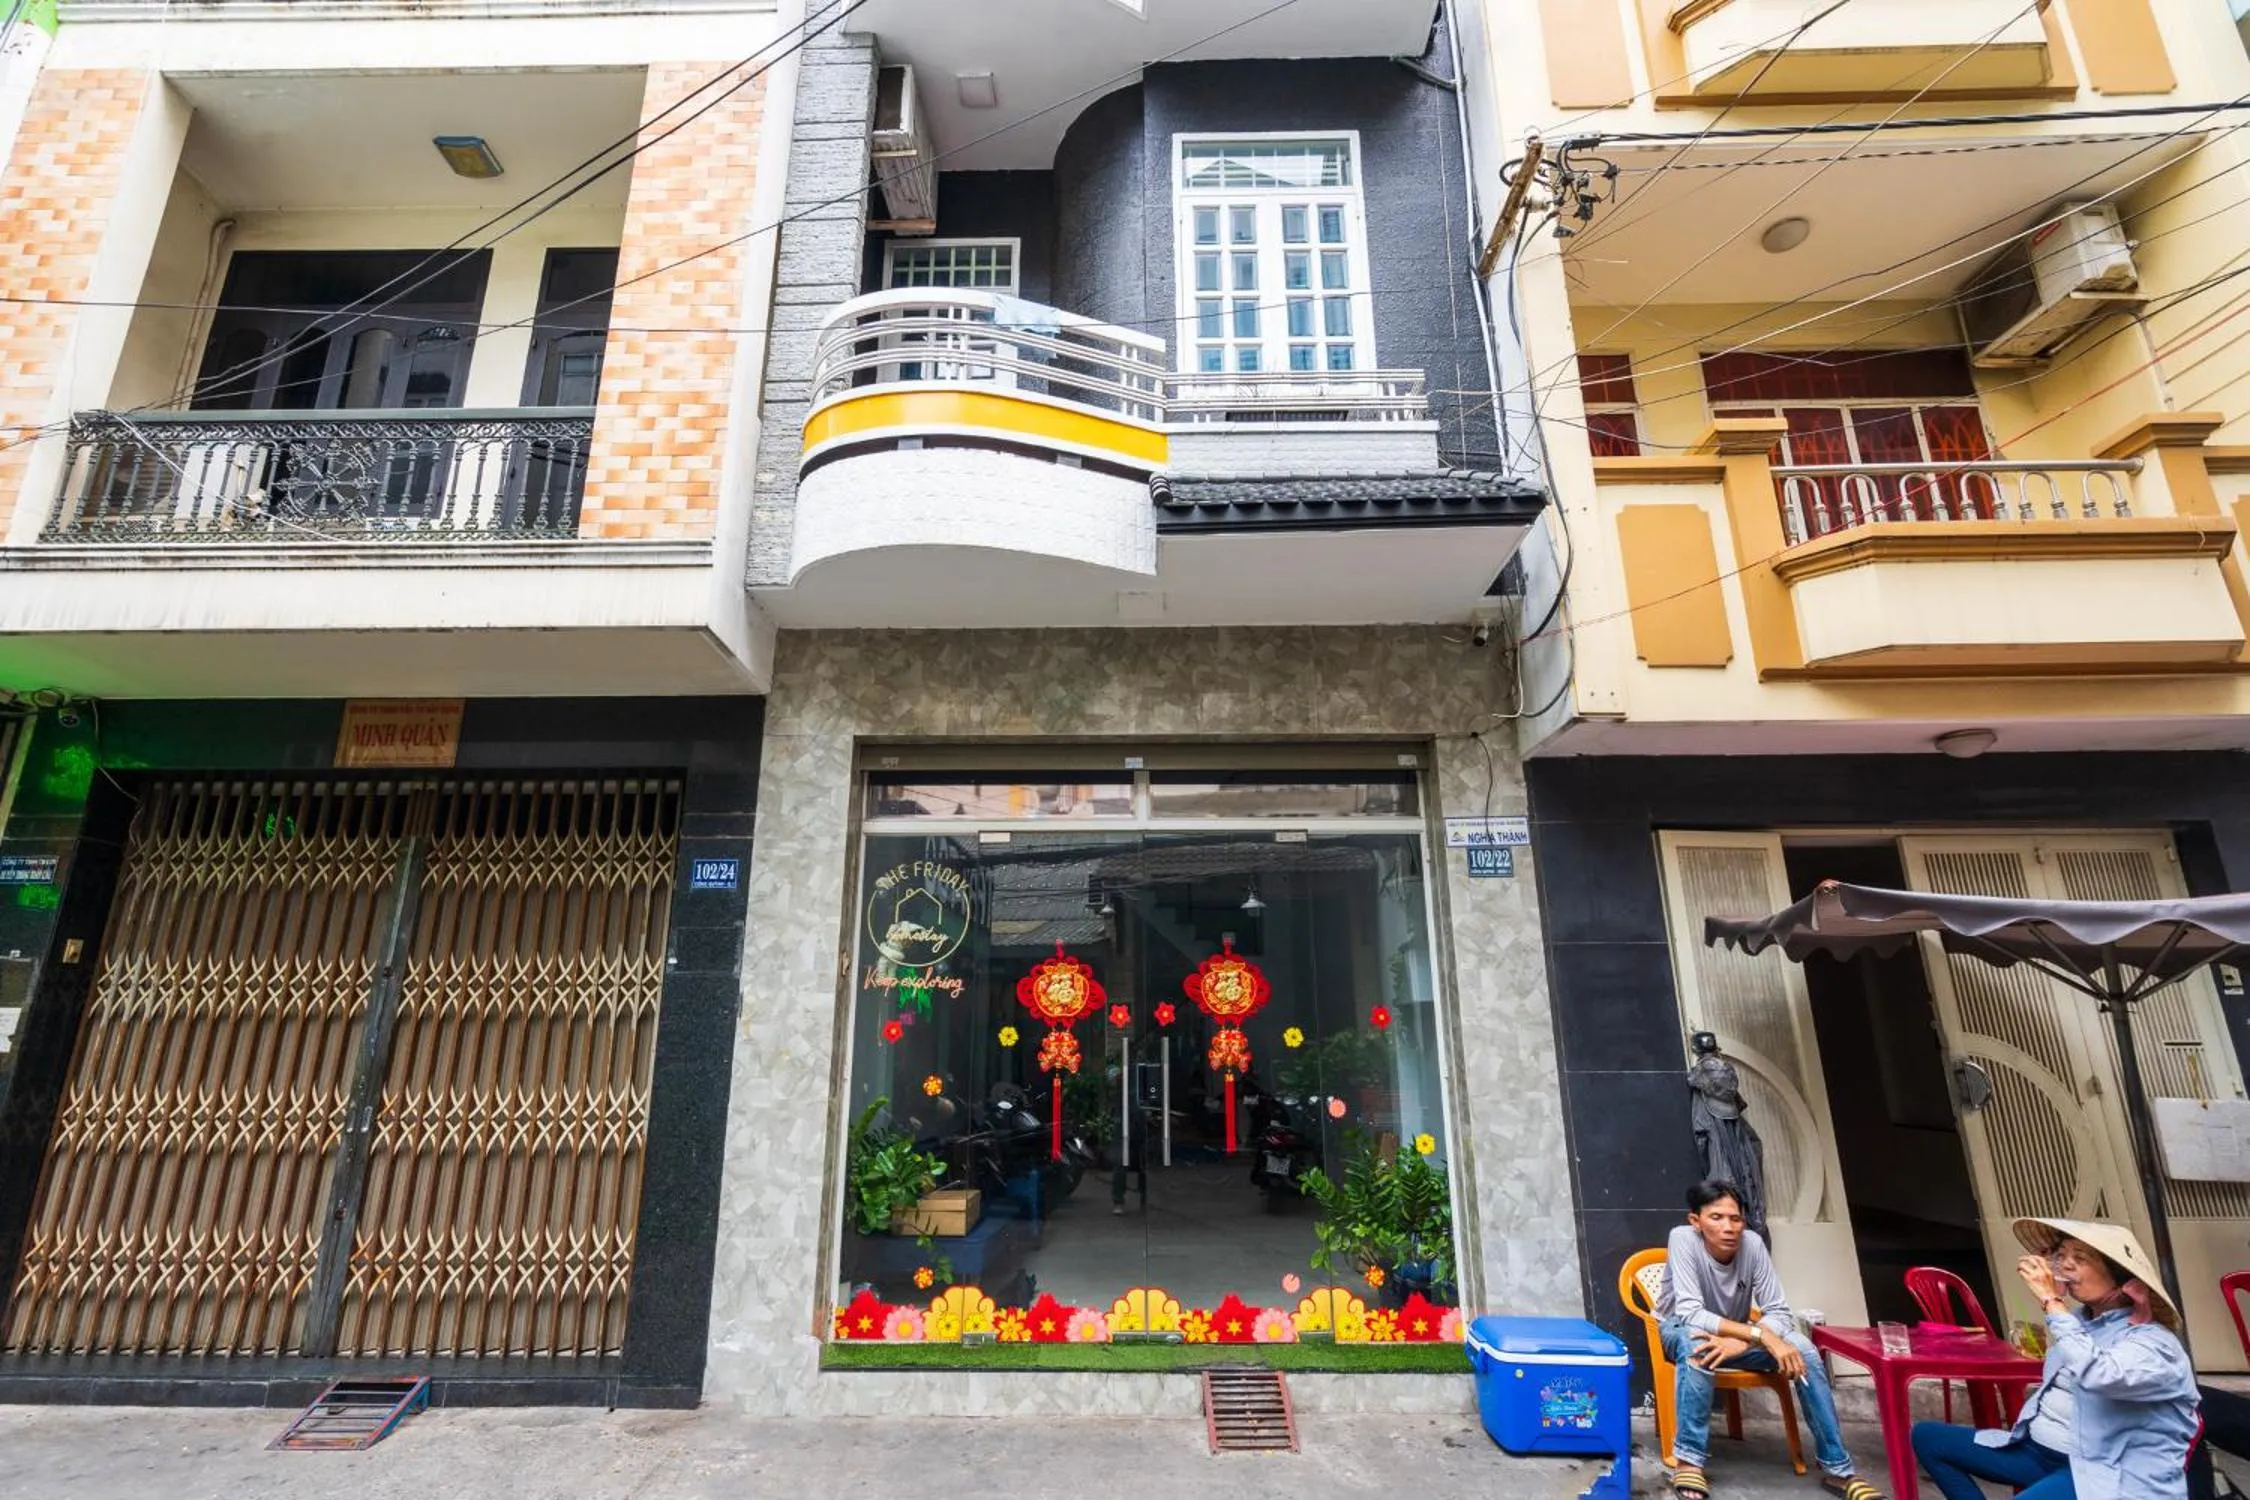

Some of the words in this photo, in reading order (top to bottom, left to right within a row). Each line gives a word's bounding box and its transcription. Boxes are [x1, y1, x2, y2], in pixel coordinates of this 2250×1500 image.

[1470, 850, 1511, 868] 102/22
[696, 863, 735, 880] 102/24
[914, 860, 969, 890] FRIDAY
[863, 965, 897, 998] Keep
